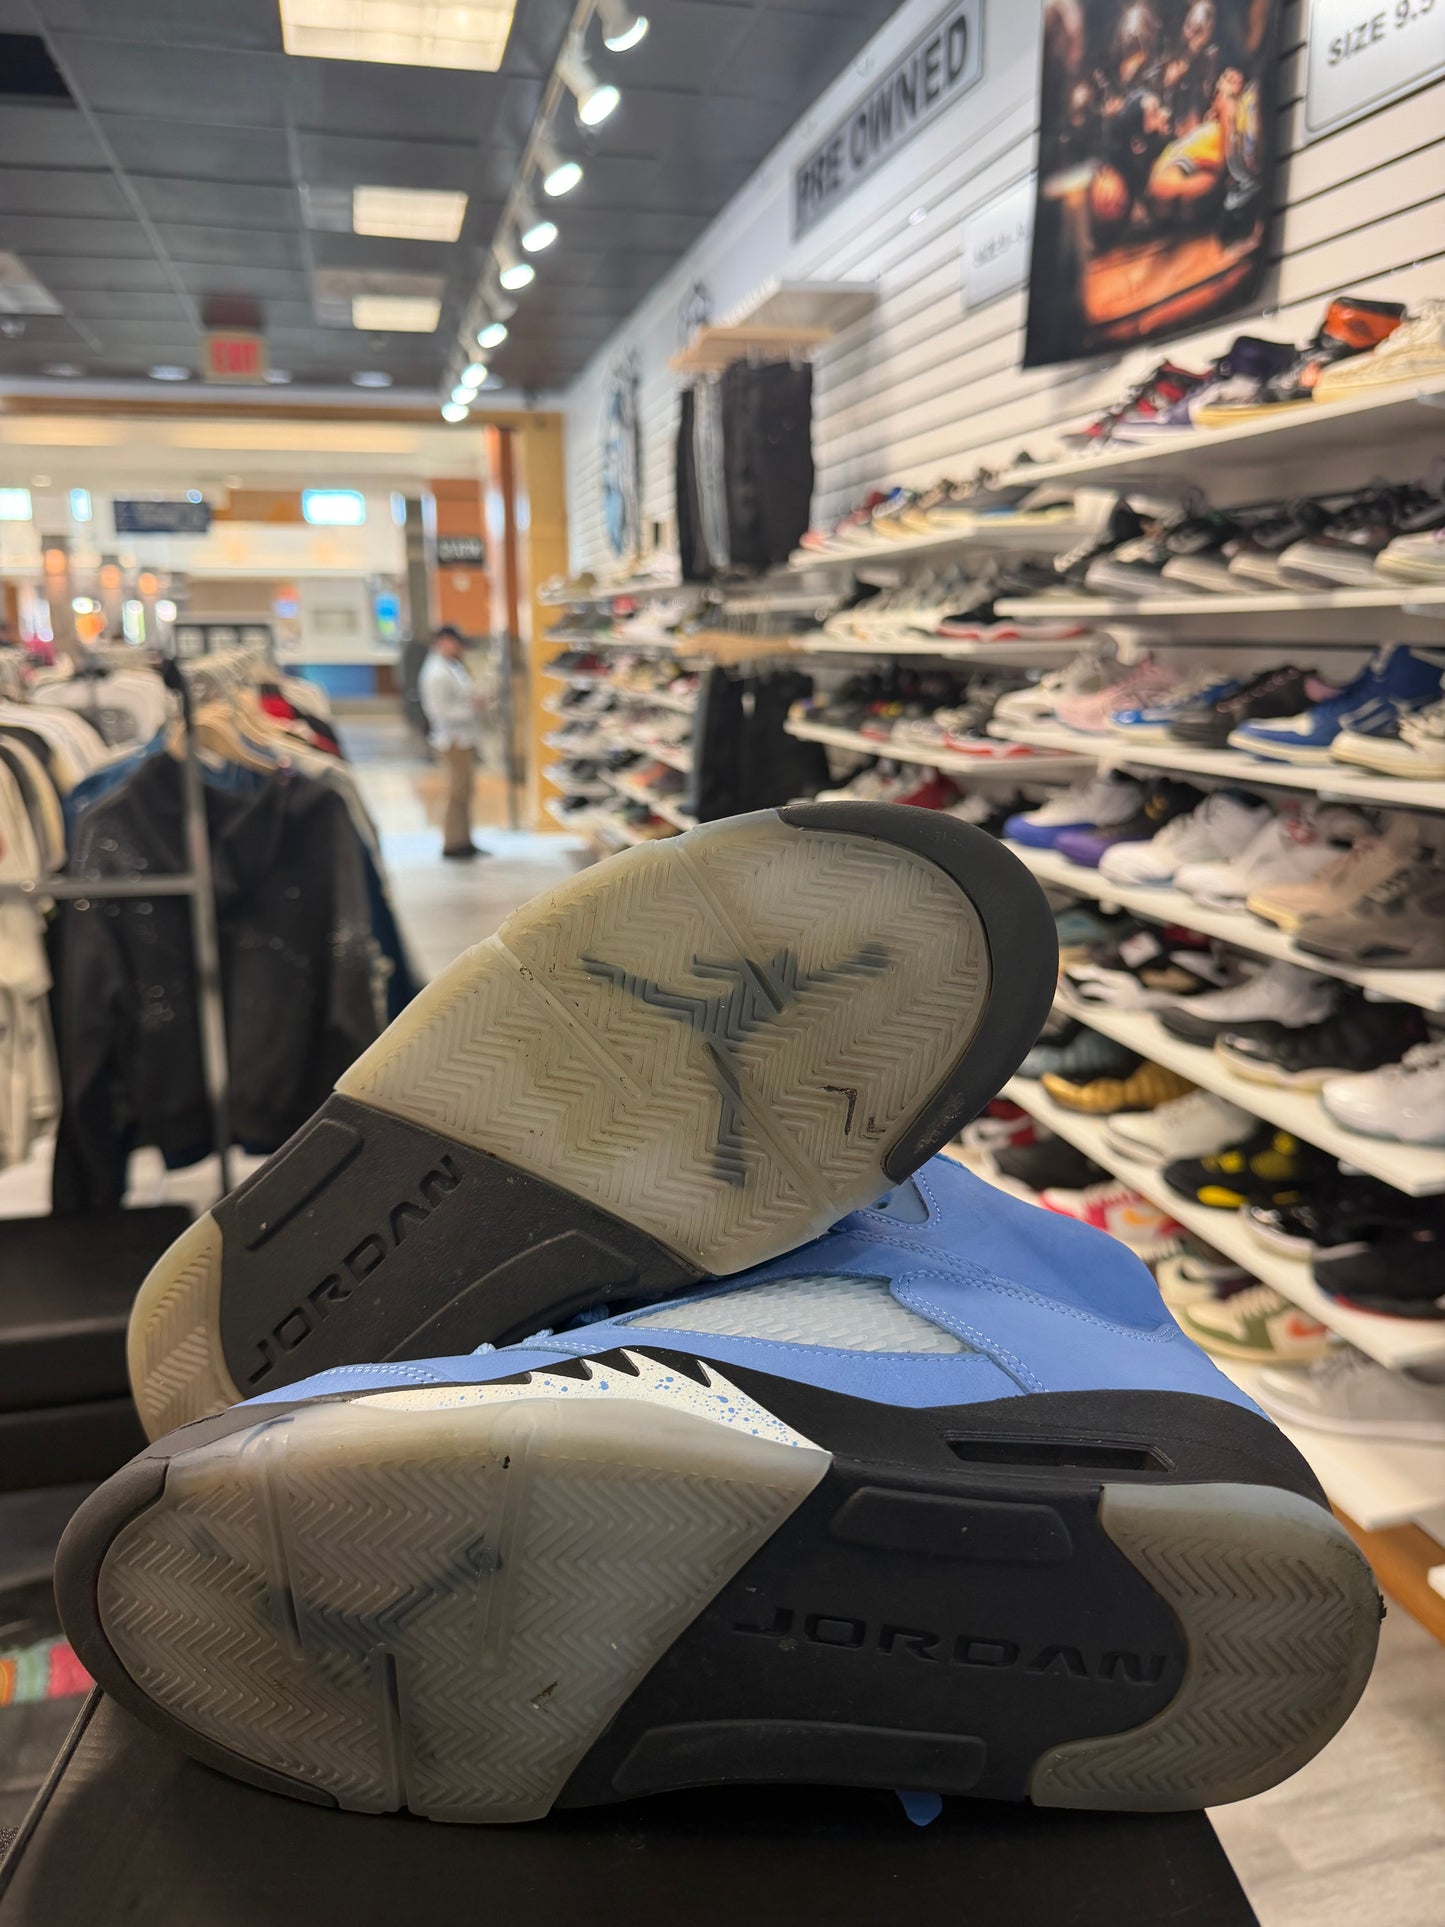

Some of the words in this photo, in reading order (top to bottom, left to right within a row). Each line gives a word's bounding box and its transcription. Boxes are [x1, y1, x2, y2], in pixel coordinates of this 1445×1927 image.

[1328, 11, 1385, 66] SIZE
[799, 138, 841, 203] PRE
[851, 15, 966, 170] OWNED
[250, 1154, 462, 1385] JORDAN
[733, 1607, 1166, 1686] JORDAN
